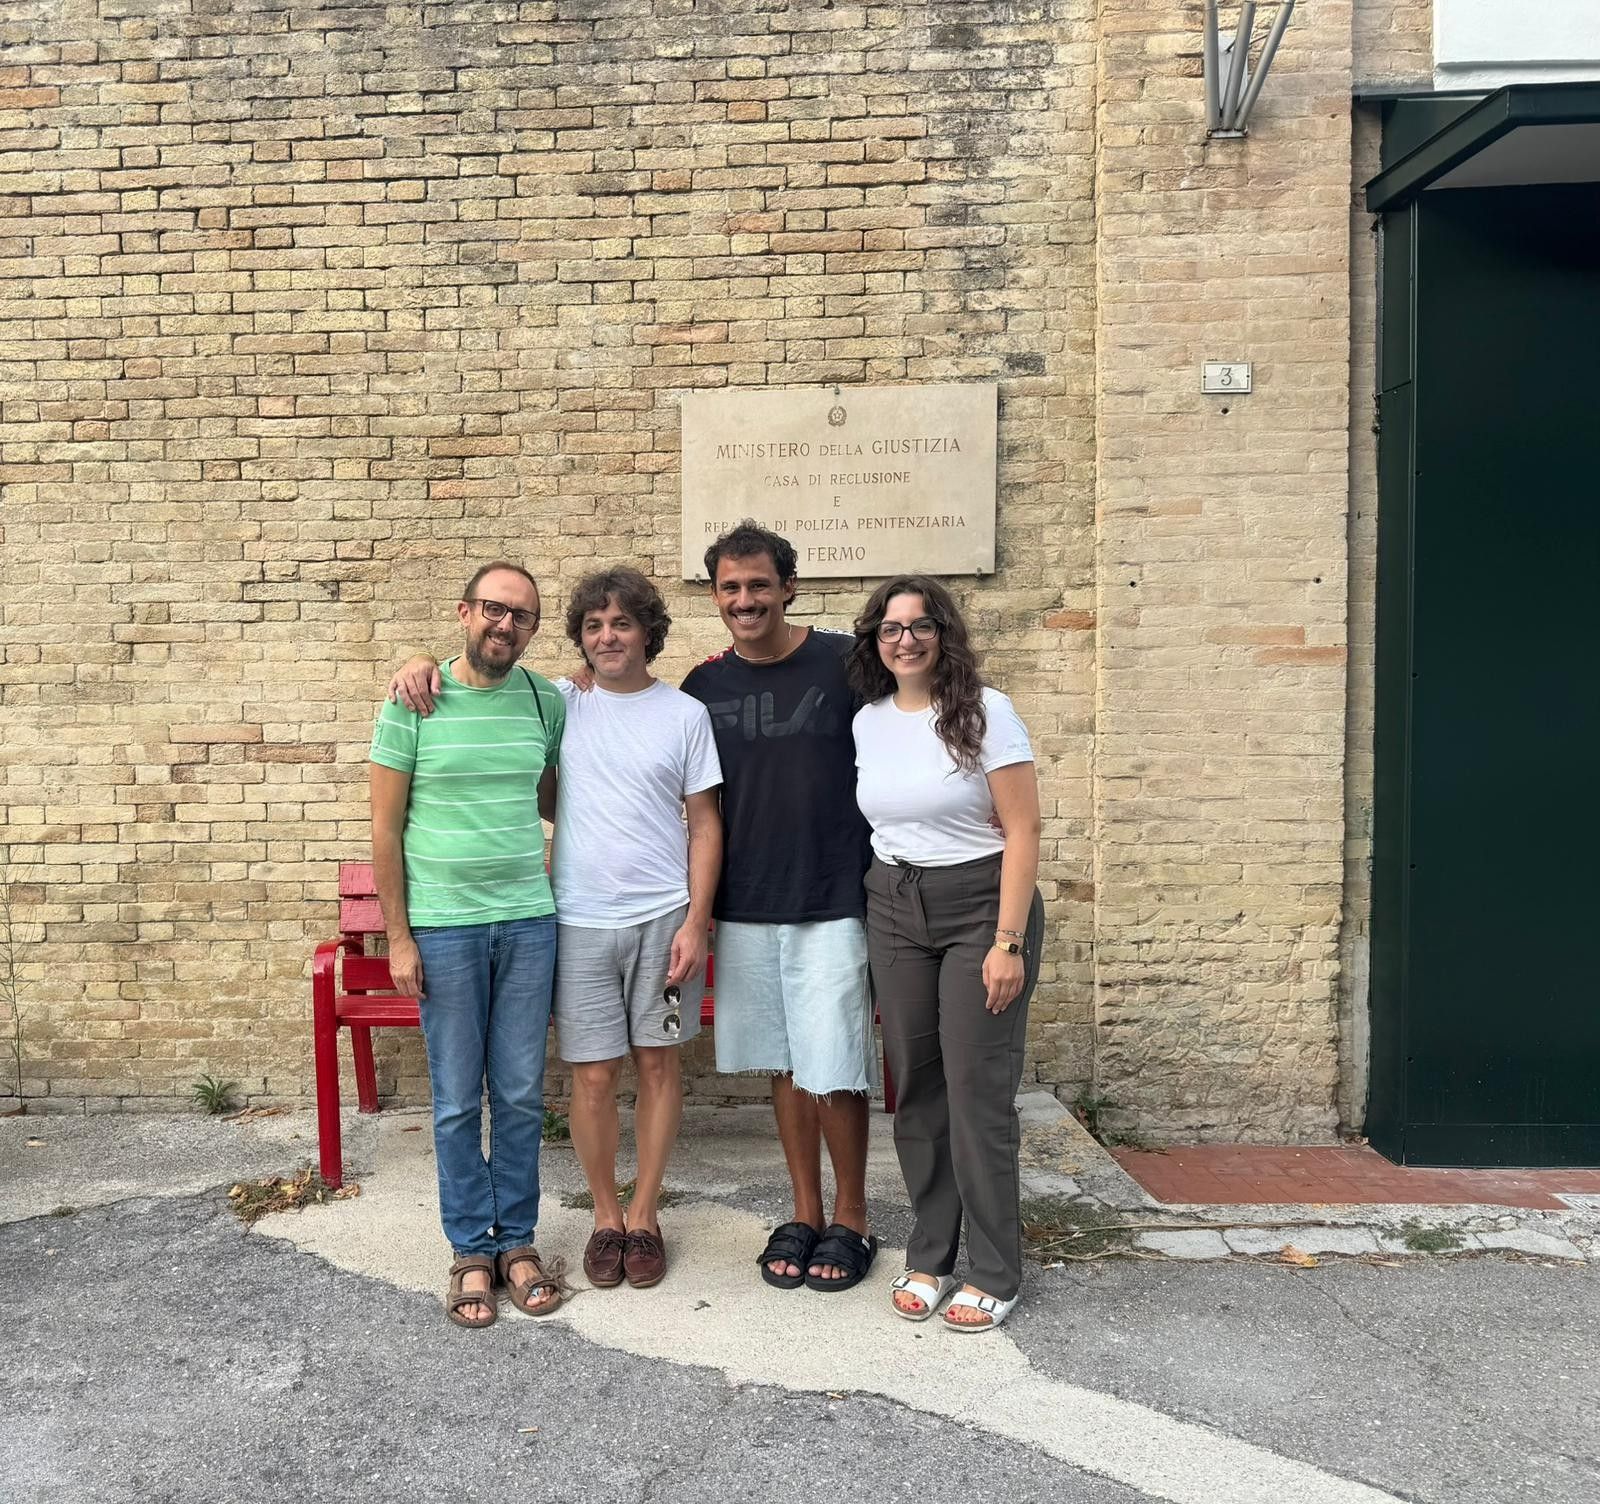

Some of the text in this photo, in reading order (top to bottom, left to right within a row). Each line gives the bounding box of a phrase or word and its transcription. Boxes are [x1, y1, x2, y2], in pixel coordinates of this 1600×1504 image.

[1220, 366, 1232, 386] 3
[716, 437, 961, 459] MINISTERO DELLA GIUSTIZIA
[763, 471, 911, 487] CASA DI RECLUSIONE
[833, 495, 841, 507] E
[774, 519, 787, 532] DI
[795, 518, 849, 532] POLIZIA
[857, 515, 966, 530] PENITENZIARIA
[807, 546, 866, 562] FERMO
